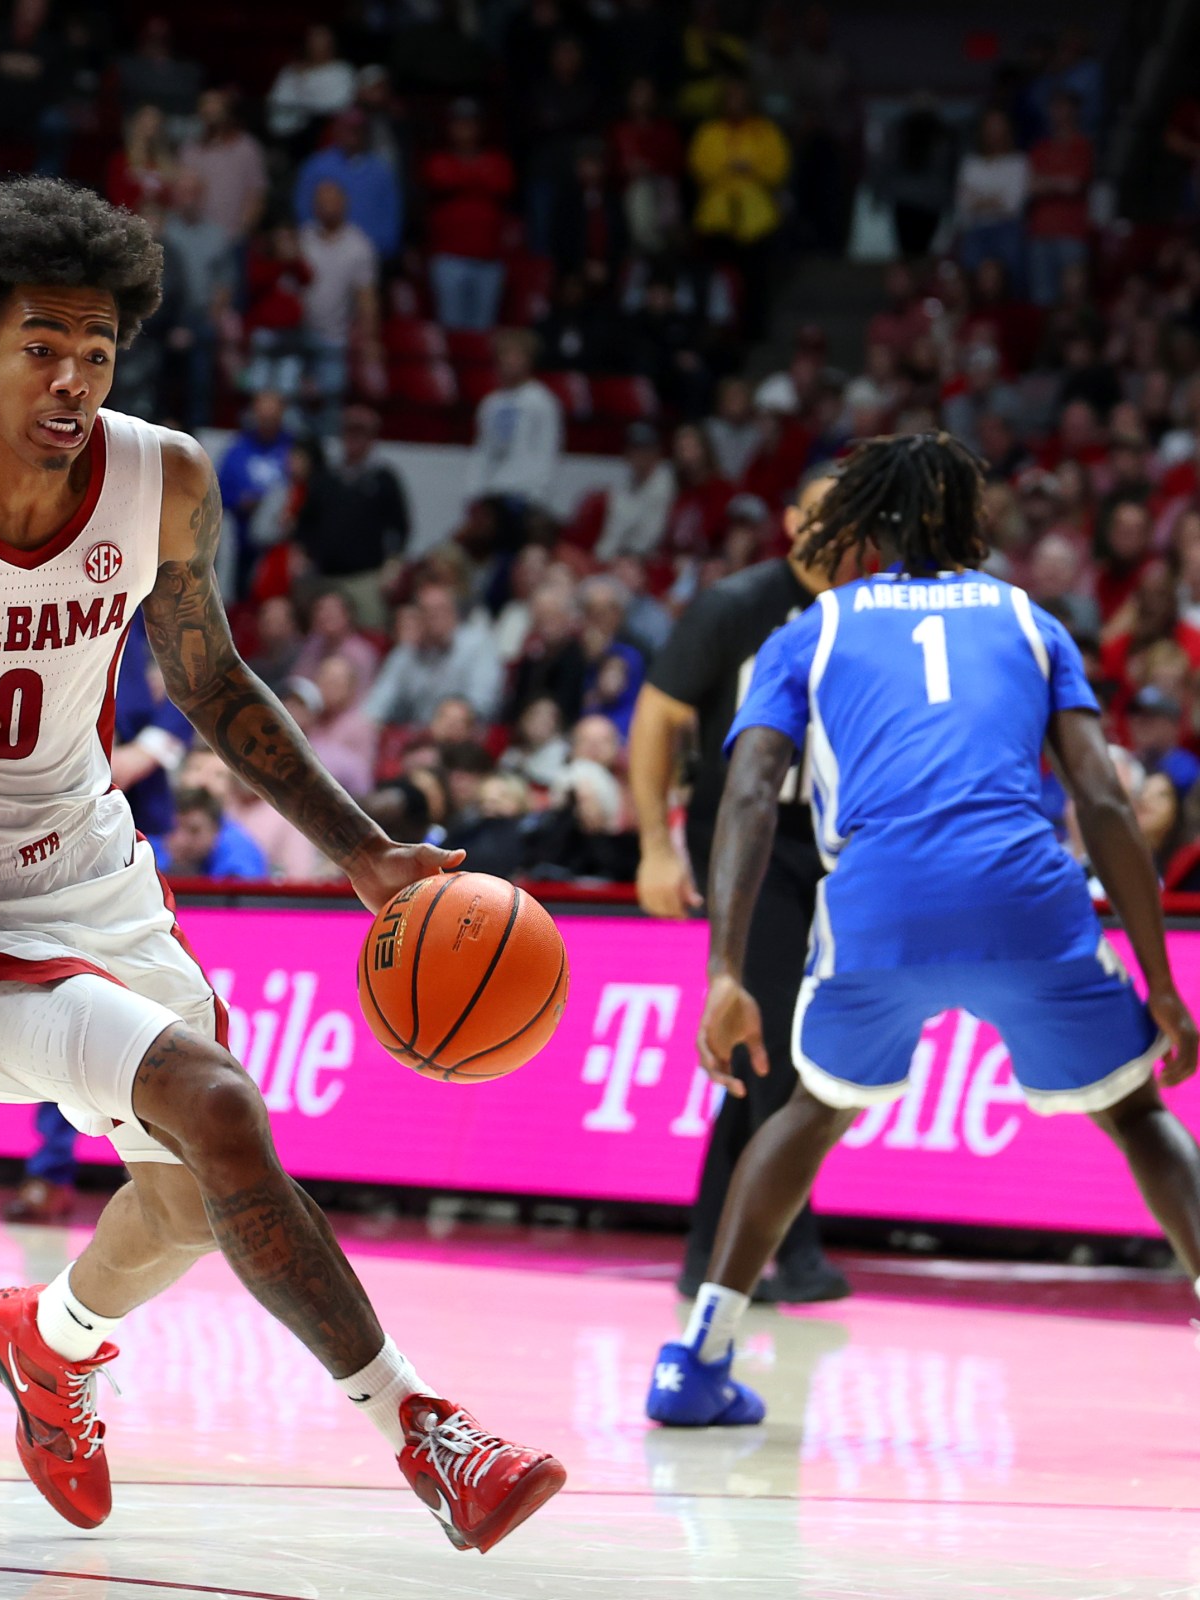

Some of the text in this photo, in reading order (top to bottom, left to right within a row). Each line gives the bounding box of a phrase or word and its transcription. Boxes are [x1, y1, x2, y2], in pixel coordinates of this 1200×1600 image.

[86, 543, 122, 582] SEC
[853, 582, 1000, 613] ABERDEEN
[912, 615, 951, 705] 1
[18, 831, 60, 868] RTR
